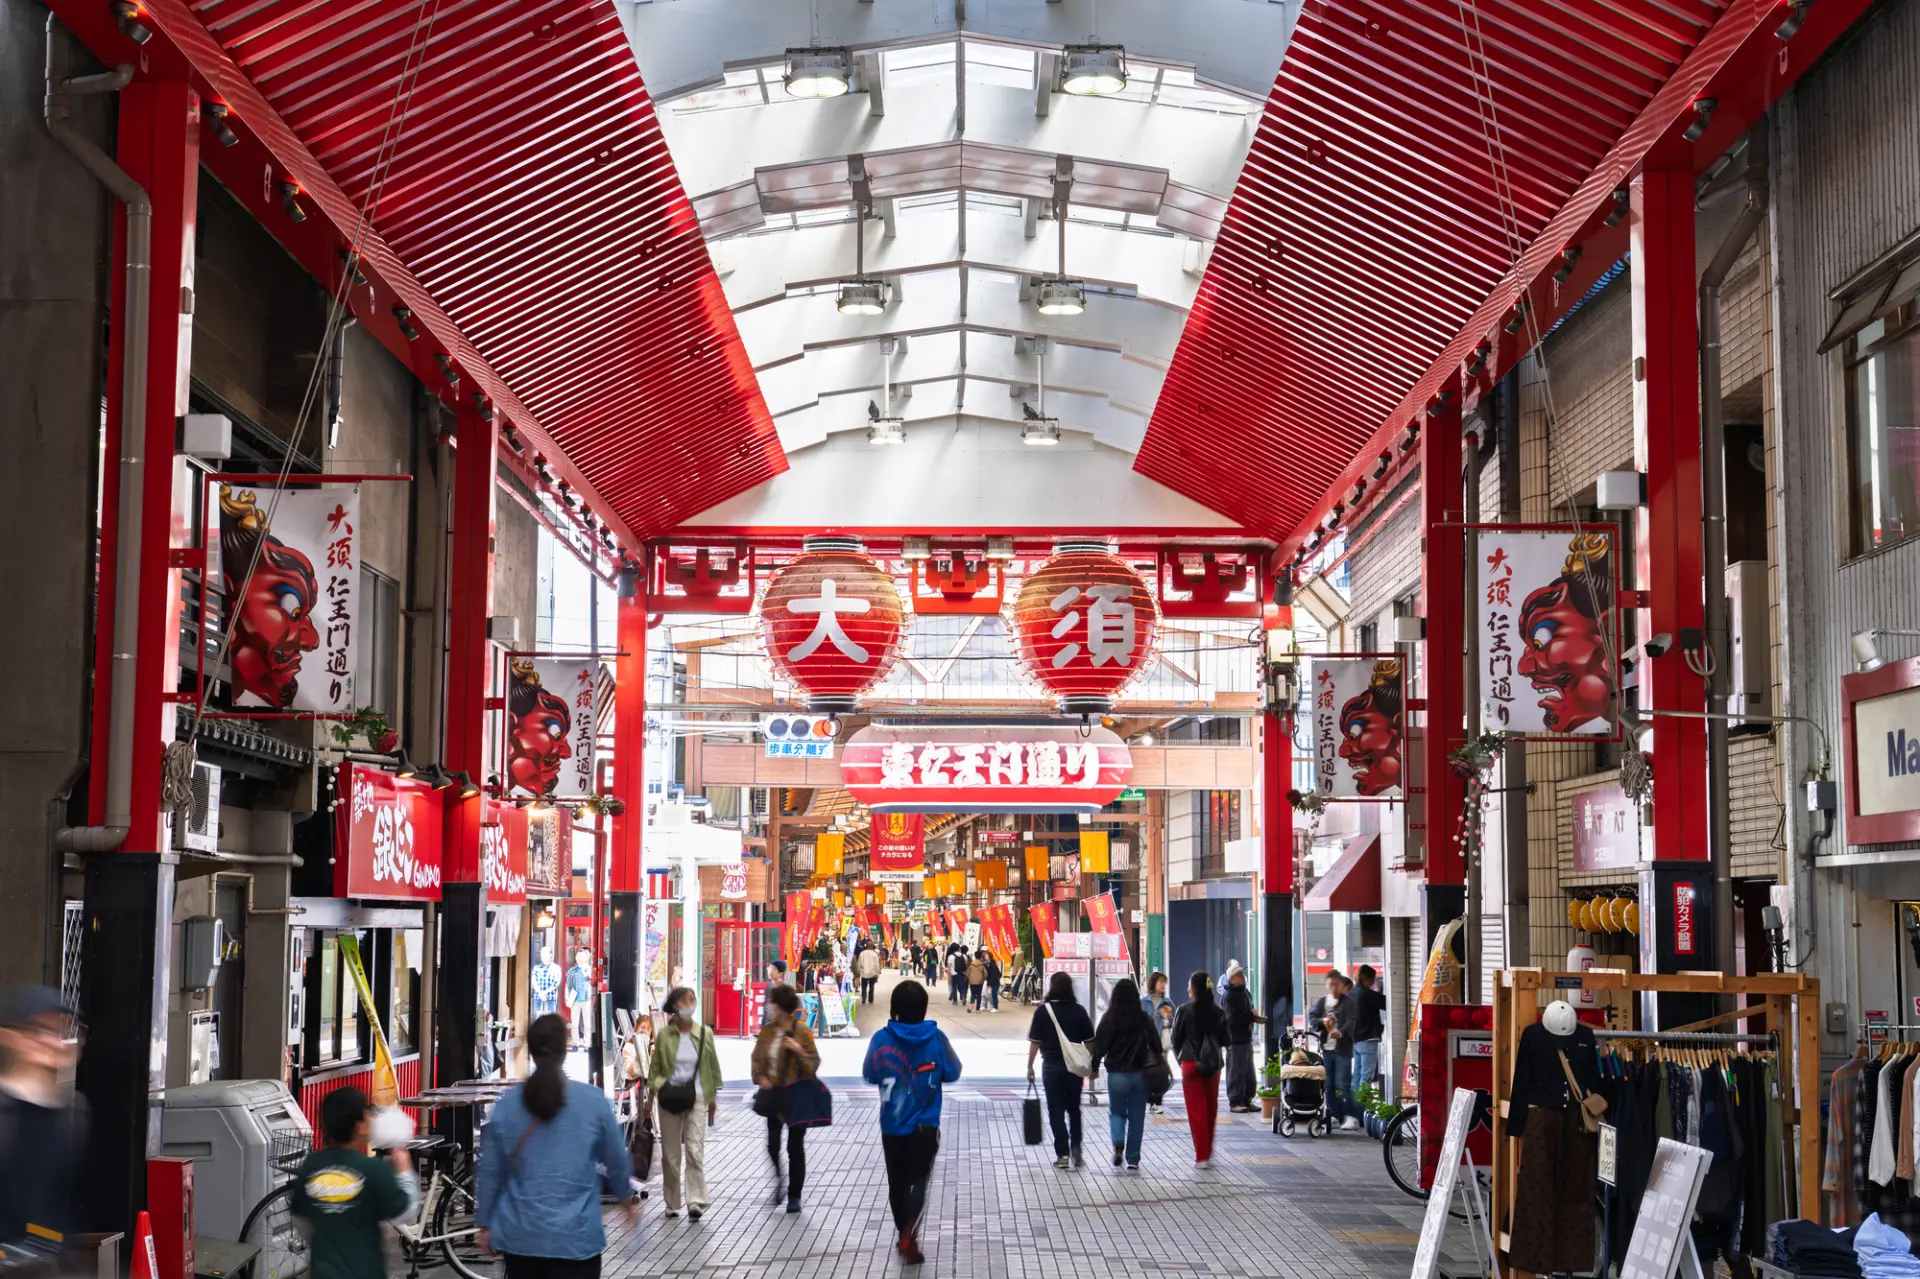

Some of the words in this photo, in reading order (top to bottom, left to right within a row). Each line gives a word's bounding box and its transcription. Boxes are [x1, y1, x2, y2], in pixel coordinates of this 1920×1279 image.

[324, 503, 353, 705] 大須仁王門通り
[786, 578, 871, 663] 大
[1050, 584, 1136, 668] 須
[1486, 547, 1516, 727] 大須仁王門通り
[354, 781, 374, 824] 築地
[373, 793, 414, 885] 銀だこ
[880, 829, 913, 841] GRAMPUS
[1676, 886, 1692, 951] 防犯カメラ設置
